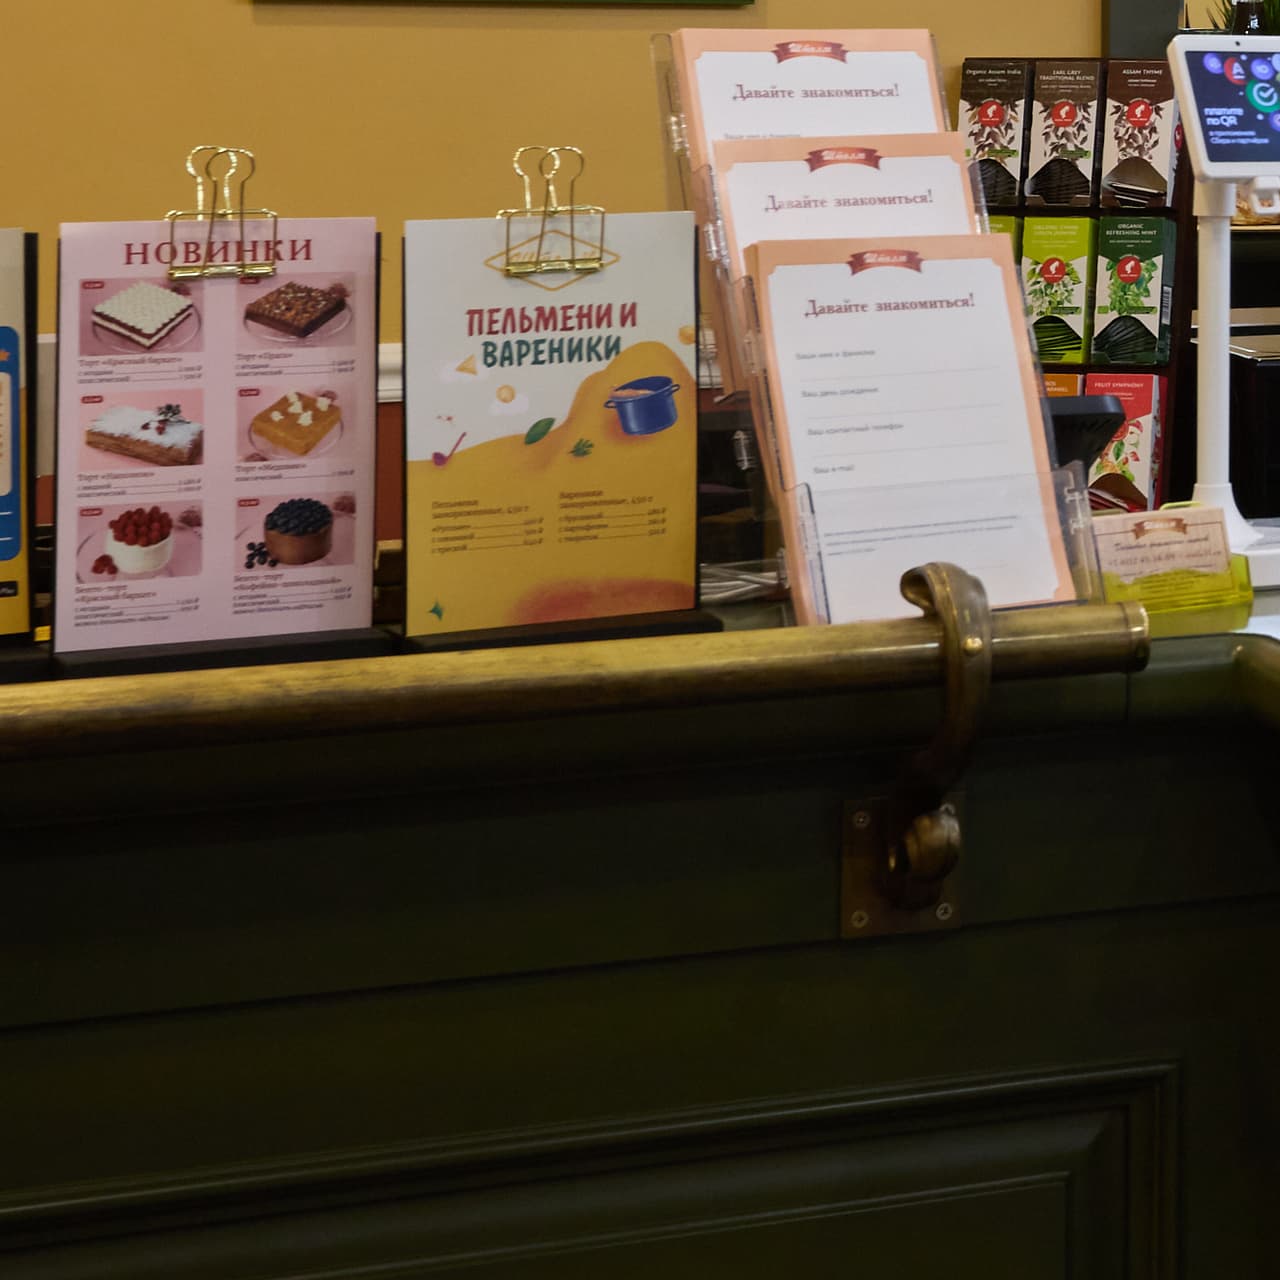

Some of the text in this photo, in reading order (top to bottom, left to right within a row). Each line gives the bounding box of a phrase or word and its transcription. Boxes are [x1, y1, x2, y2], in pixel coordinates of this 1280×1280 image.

[732, 82, 900, 102] Давайте знакомиться!
[764, 188, 934, 212] Давайте знакомиться!
[124, 239, 312, 265] НОВИНКИ
[804, 292, 976, 317] Давайте знакомиться!
[466, 302, 638, 337] ПЕЛЬМЕНИ И
[481, 334, 622, 368] ВАРЕНИКИ
